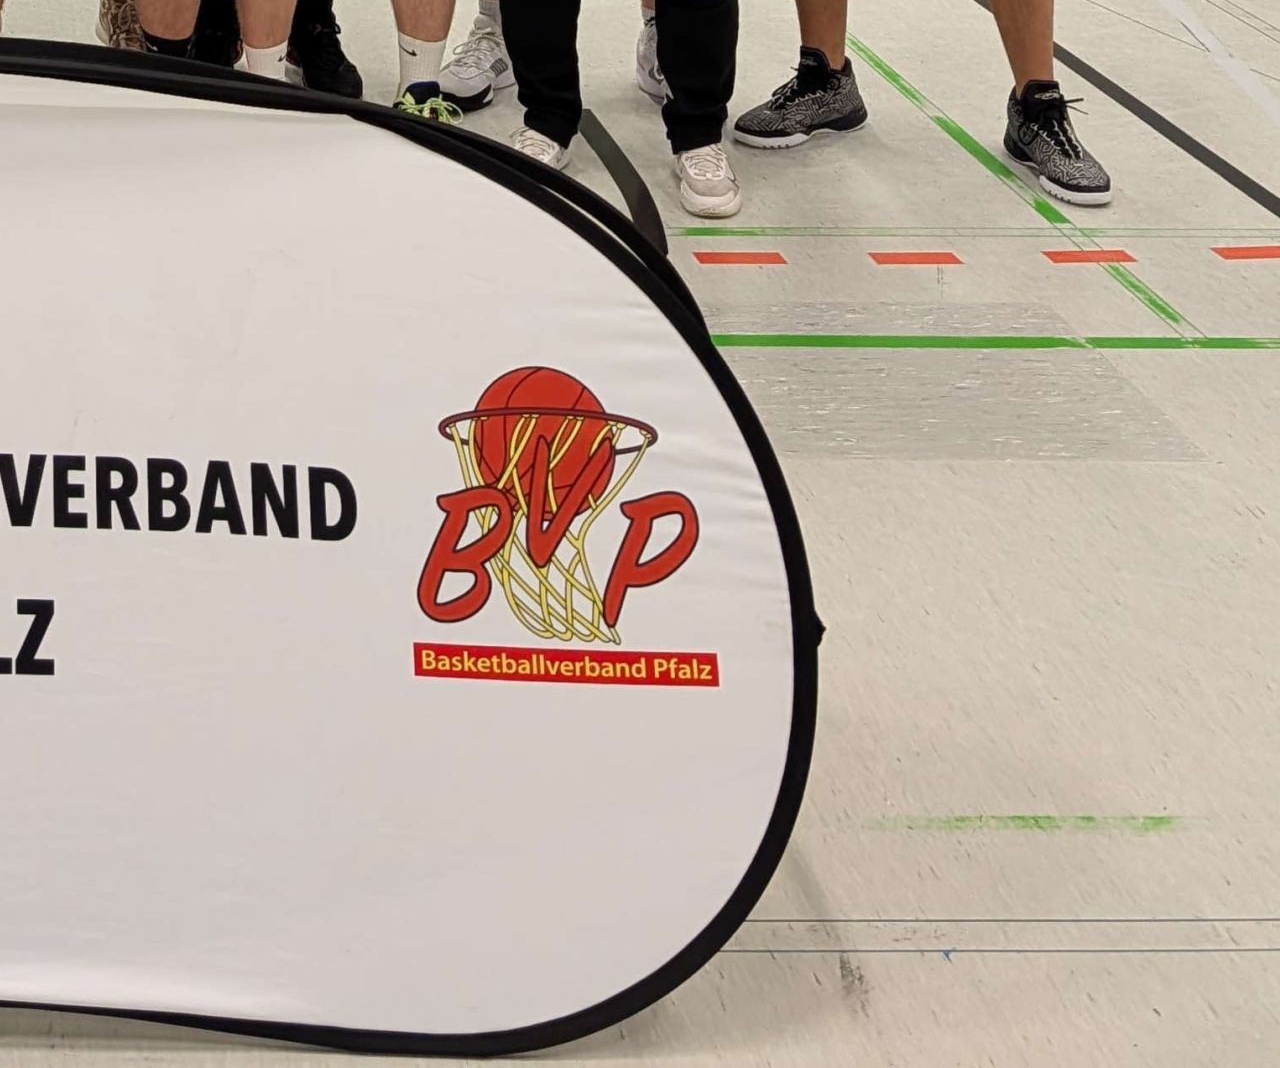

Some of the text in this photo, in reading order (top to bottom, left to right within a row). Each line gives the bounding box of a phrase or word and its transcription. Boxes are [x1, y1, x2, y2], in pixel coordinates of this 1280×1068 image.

[417, 434, 700, 628] BVP
[421, 650, 713, 681] Basketballverband Pfalz
